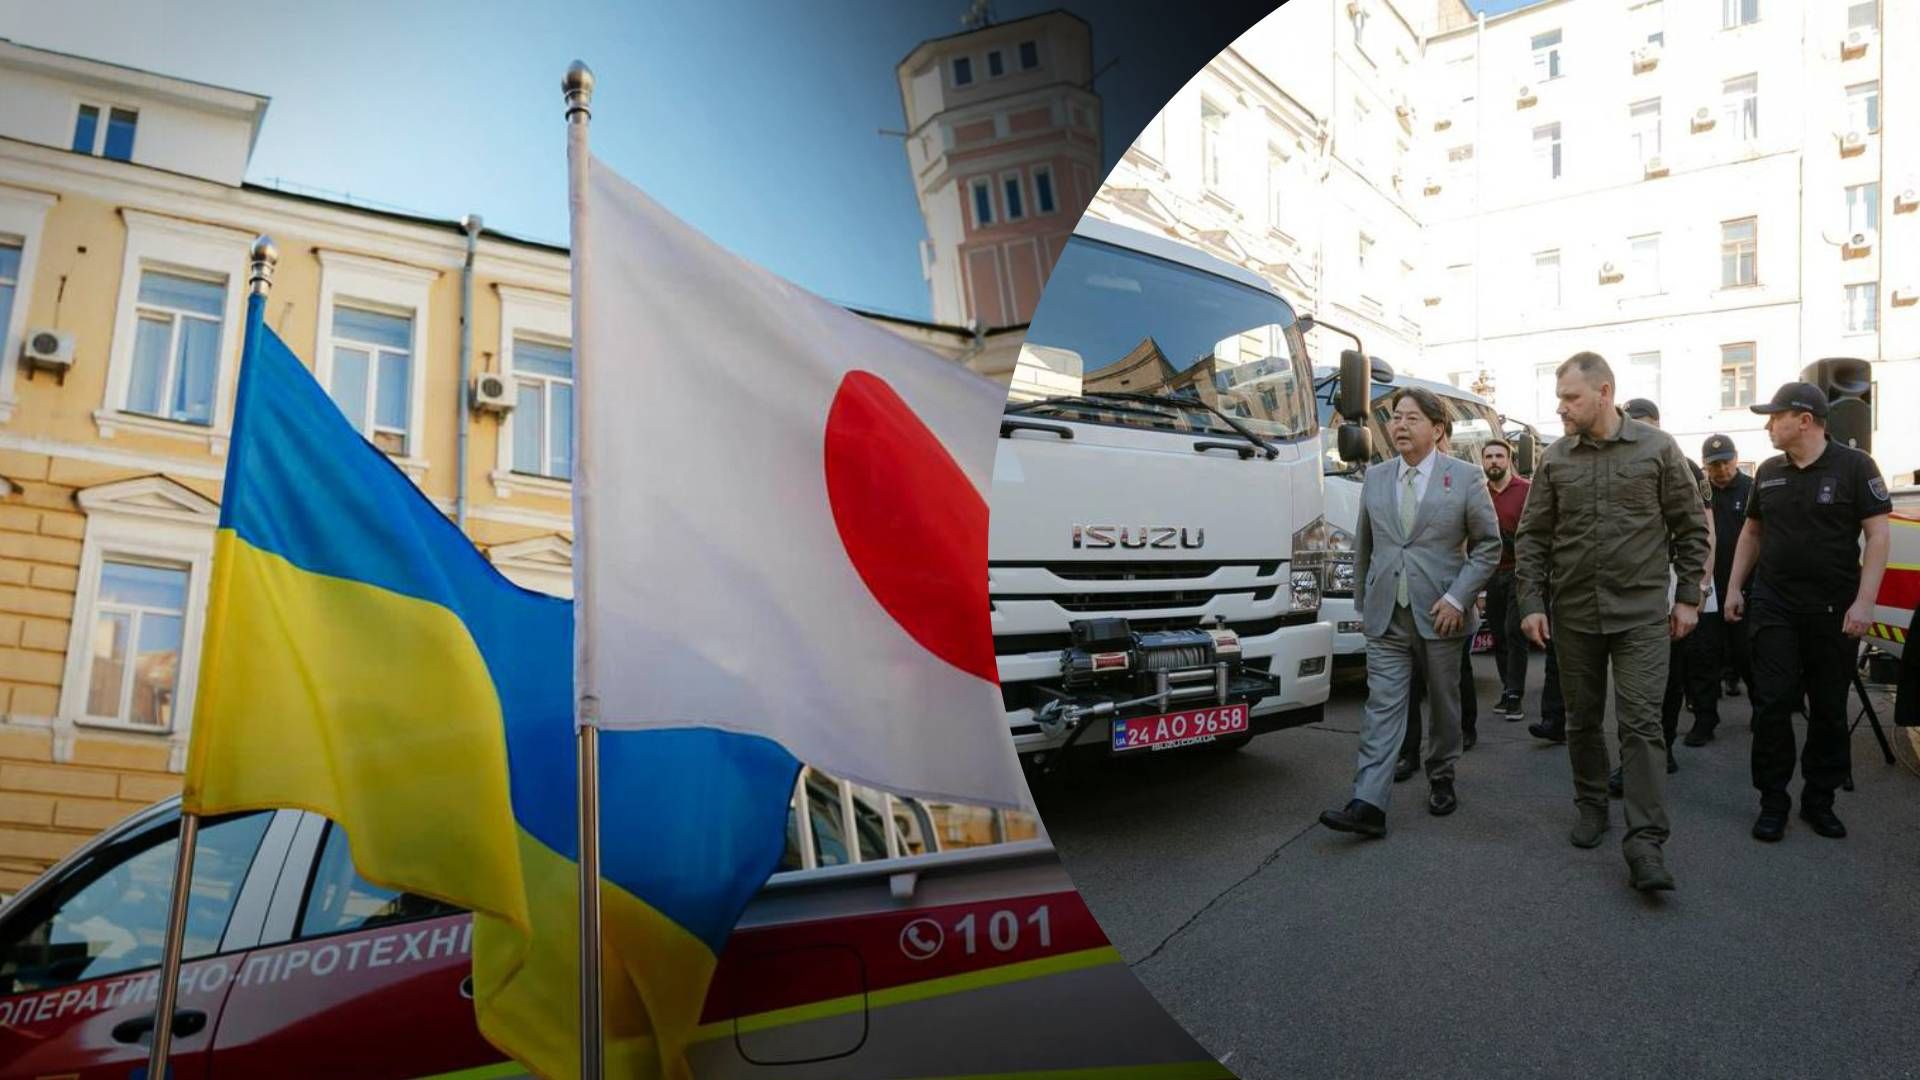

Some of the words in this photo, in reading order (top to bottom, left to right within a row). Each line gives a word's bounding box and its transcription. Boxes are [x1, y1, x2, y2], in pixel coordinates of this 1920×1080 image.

[1072, 525, 1205, 549] ISUZU
[1128, 728, 1149, 745] 24
[1155, 716, 1187, 740] AO
[1194, 708, 1241, 735] 9658
[1116, 738, 1126, 746] UA
[954, 904, 1051, 955] 101
